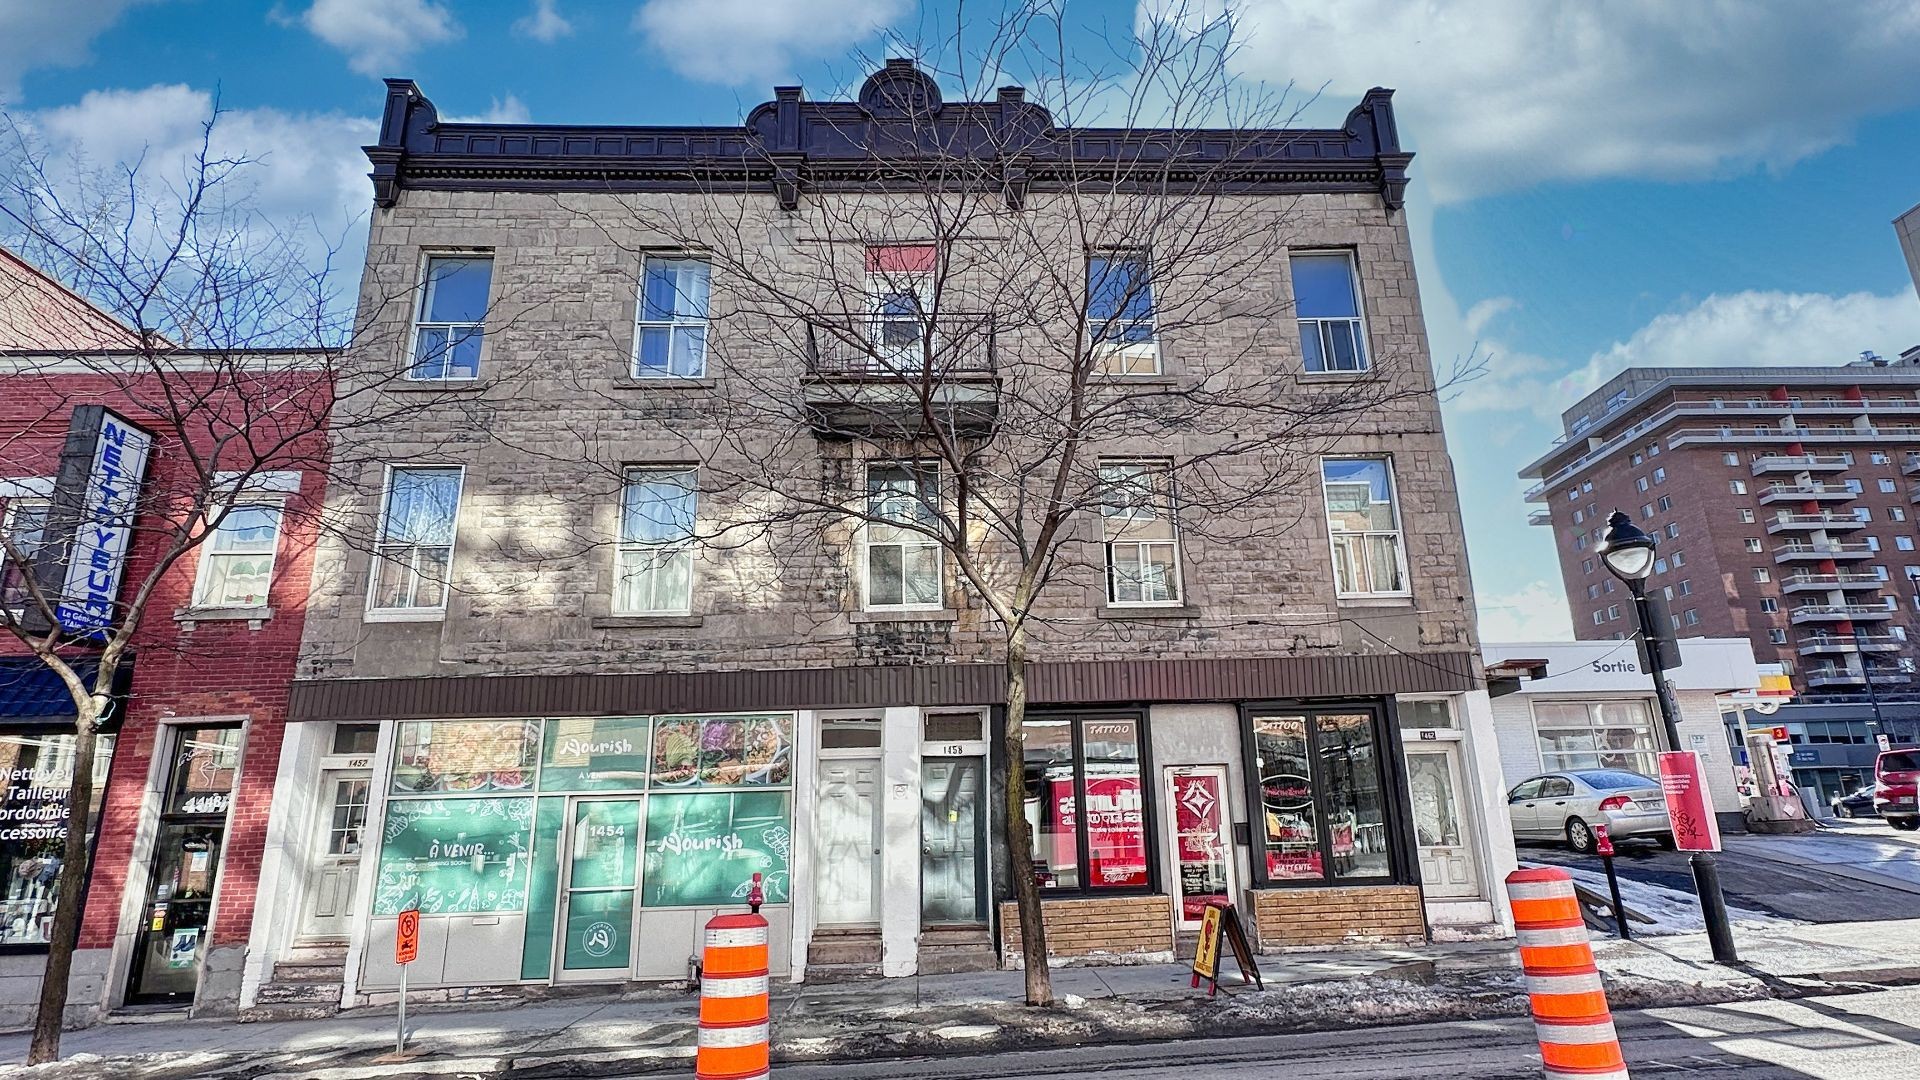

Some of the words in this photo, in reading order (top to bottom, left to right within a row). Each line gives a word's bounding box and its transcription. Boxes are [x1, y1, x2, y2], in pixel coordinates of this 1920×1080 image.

[62, 610, 71, 618] Le
[1592, 660, 1636, 673] Sortie
[1089, 725, 1129, 734] TATTOO
[1261, 721, 1298, 730] TATTOO
[1775, 728, 1783, 738] 3
[560, 738, 632, 757] Nourish
[943, 745, 963, 754] 1458
[348, 759, 368, 768] 1452
[0, 805, 70, 820] ordonnie
[0, 826, 68, 840] cessoire
[590, 825, 625, 837] 1454
[429, 839, 439, 858] À
[657, 832, 743, 855] Nourish
